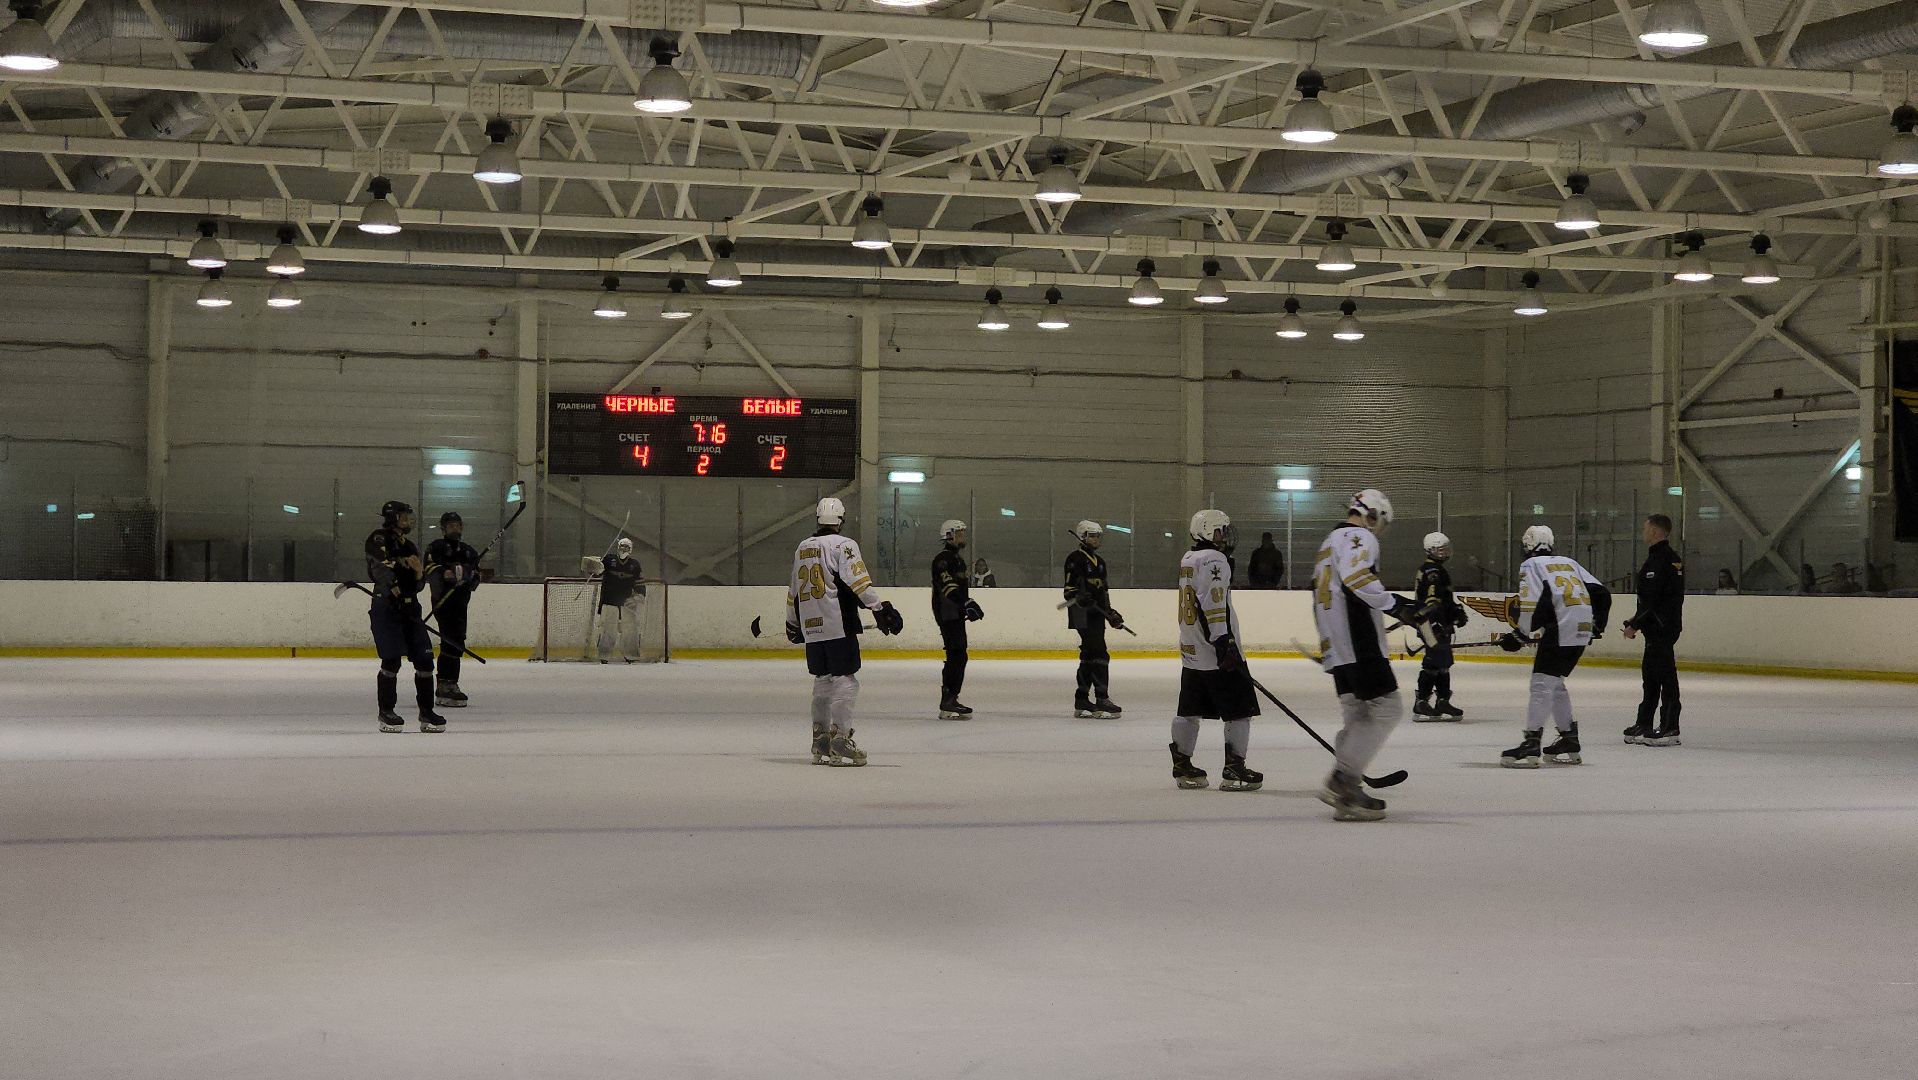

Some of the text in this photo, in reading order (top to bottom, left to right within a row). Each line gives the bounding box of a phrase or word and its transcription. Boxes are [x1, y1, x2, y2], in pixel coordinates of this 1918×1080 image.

[556, 402, 597, 411] УДАЛЕНИЯ
[605, 396, 676, 413] ЧЕРНЫЕ
[742, 398, 802, 415] БЕЛЫЕ
[618, 433, 650, 442] СЧЕТ
[692, 423, 726, 444] 7:16
[756, 435, 788, 445] СЧЕТ
[633, 444, 649, 467] 4
[687, 446, 721, 454] ПЕРИОД
[770, 446, 786, 471] 2
[697, 455, 710, 475] 2
[798, 563, 826, 602] 29
